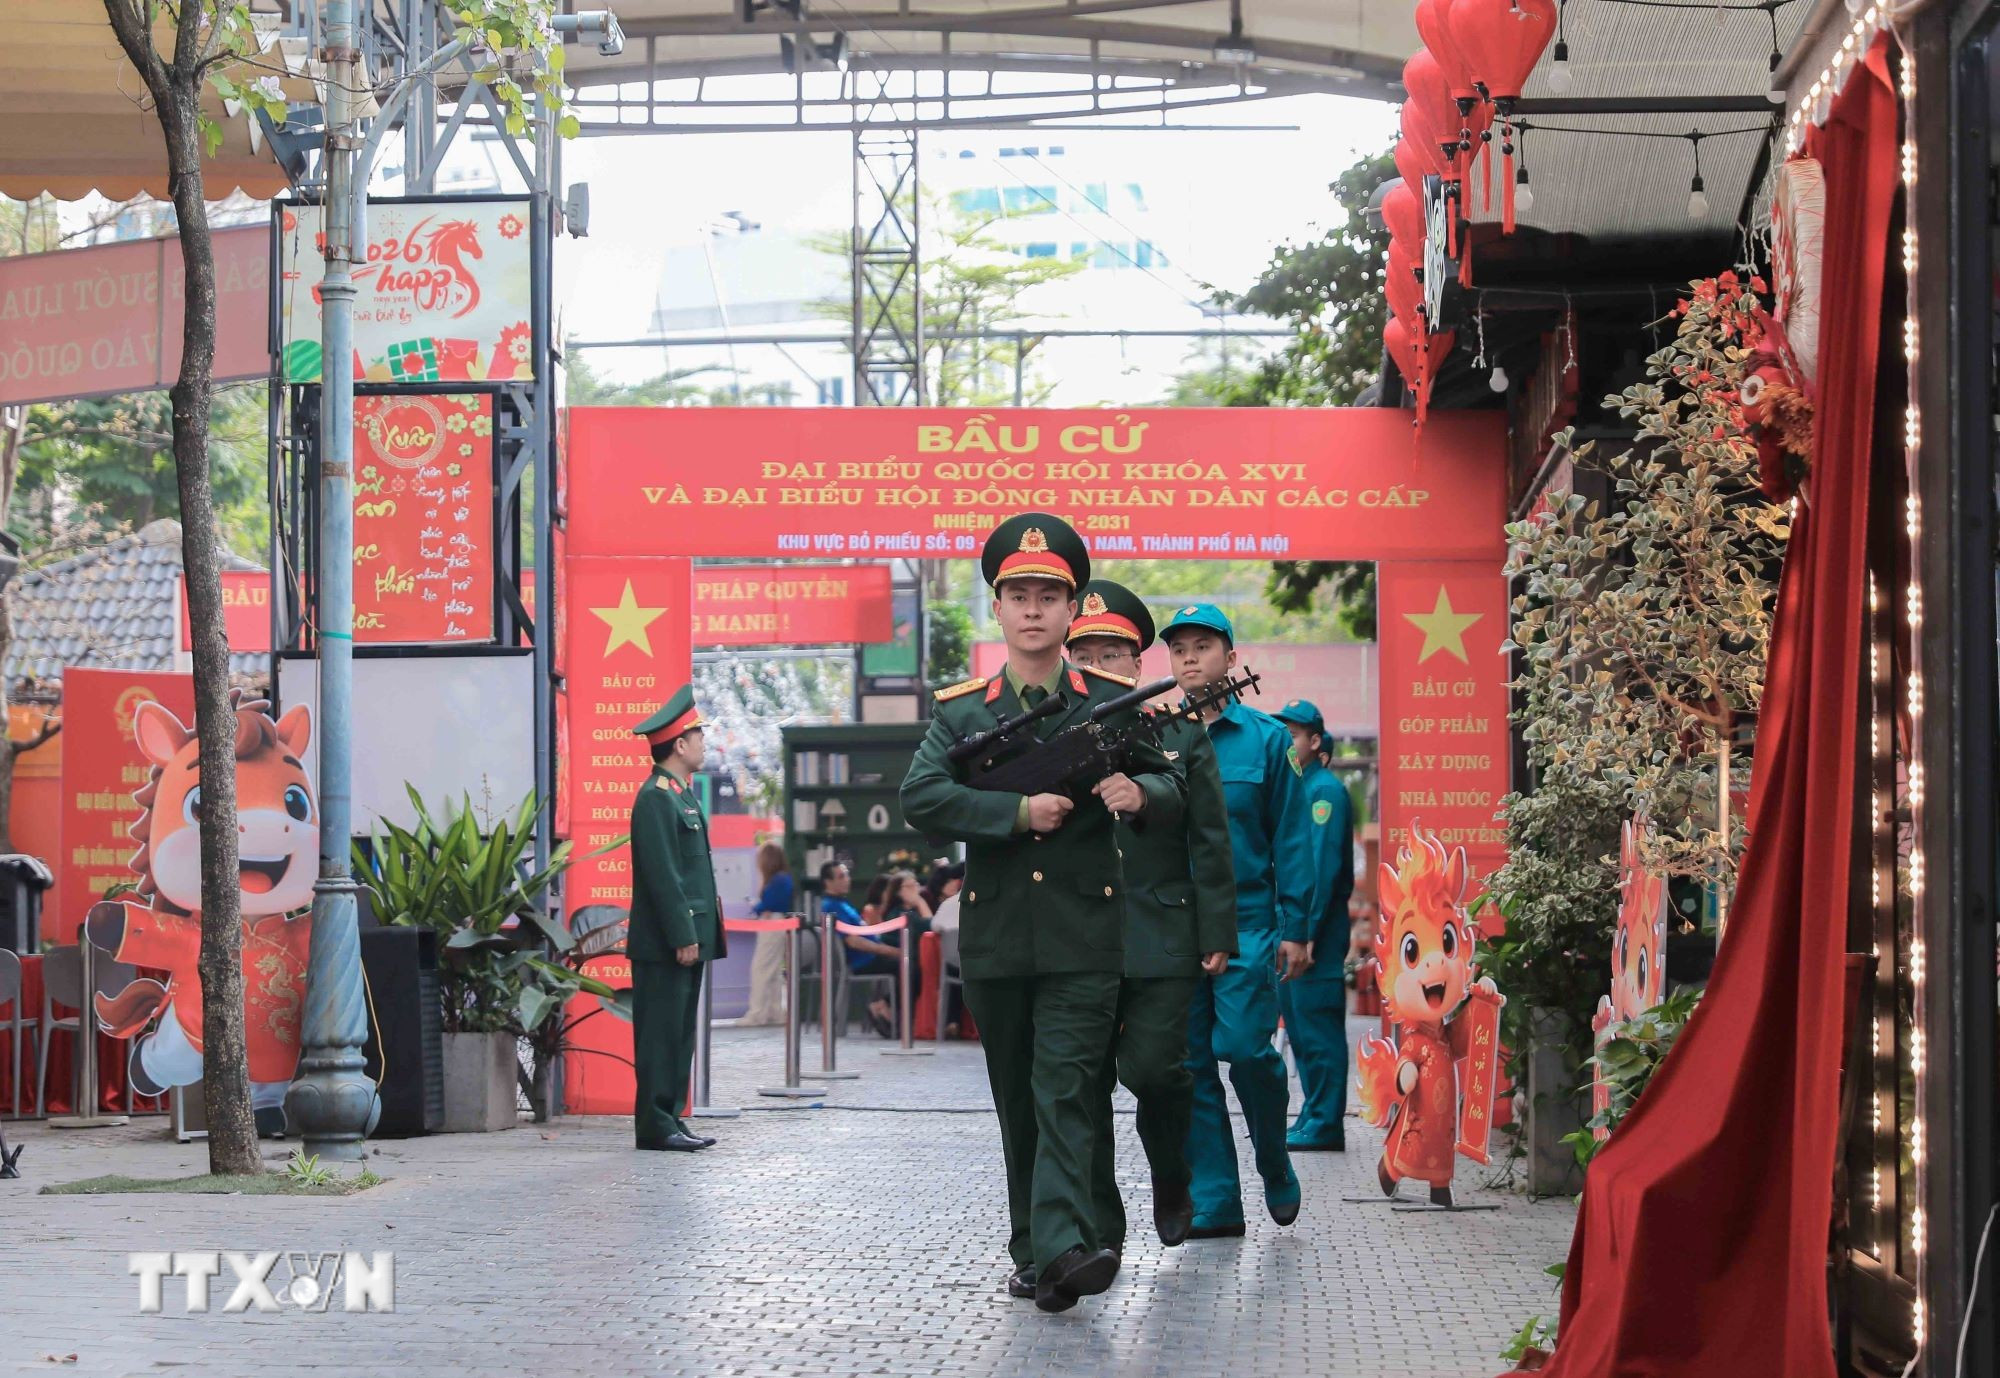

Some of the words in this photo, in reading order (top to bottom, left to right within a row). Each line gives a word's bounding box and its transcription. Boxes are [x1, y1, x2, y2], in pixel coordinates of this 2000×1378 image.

[918, 414, 1040, 453] BẦU
[1059, 414, 1149, 453] CỬ
[761, 462, 827, 482] ĐẠI
[838, 455, 924, 480] BIỂU
[934, 457, 1035, 481] QUỐC
[1044, 459, 1111, 483] HỘI
[1122, 459, 1228, 481] KHÓA
[1240, 463, 1307, 481] XVI
[641, 483, 692, 504] VÀ
[703, 487, 767, 508] ĐẠI
[779, 480, 864, 505] BIỂU
[875, 485, 941, 508] HỘI
[953, 481, 1058, 506] ĐỒNG
[1068, 485, 1176, 507] NHÂN
[1187, 485, 1267, 507] DÂN
[1277, 486, 1348, 507] CÁC
[1358, 484, 1430, 508] CẤP
[933, 511, 994, 531] NHIỆM
[1086, 515, 1130, 529] 2031
[778, 534, 809, 549] KHU
[814, 534, 844, 552] VỰC
[848, 531, 870, 550] BỎ
[875, 531, 921, 550] PHIẾU
[925, 531, 951, 549] SỐ:
[955, 535, 975, 549] 09
[1095, 536, 1137, 552] NAM,
[1141, 533, 1194, 551] THÀNH
[1200, 532, 1231, 551] PHỐ
[1235, 534, 1256, 551] HÀ
[1261, 534, 1289, 554] NỘI
[696, 578, 760, 600] PHÁP
[764, 573, 848, 599] QUYỀN
[707, 614, 777, 634] MẠNH
[603, 672, 632, 688] BẦU
[1412, 676, 1447, 696] BẦU
[595, 703, 622, 716] ĐẠI
[1400, 715, 1434, 733] GÓP
[1440, 712, 1488, 733] PHẦN
[592, 726, 633, 740] QUỐC
[592, 753, 634, 766] KHÓA
[1399, 753, 1437, 769] XÂY
[584, 779, 604, 792] VÀ
[608, 781, 634, 793] ĐẠI
[1400, 789, 1437, 806] NHÀ
[592, 806, 618, 820] HỘI
[598, 859, 627, 872] CÁC
